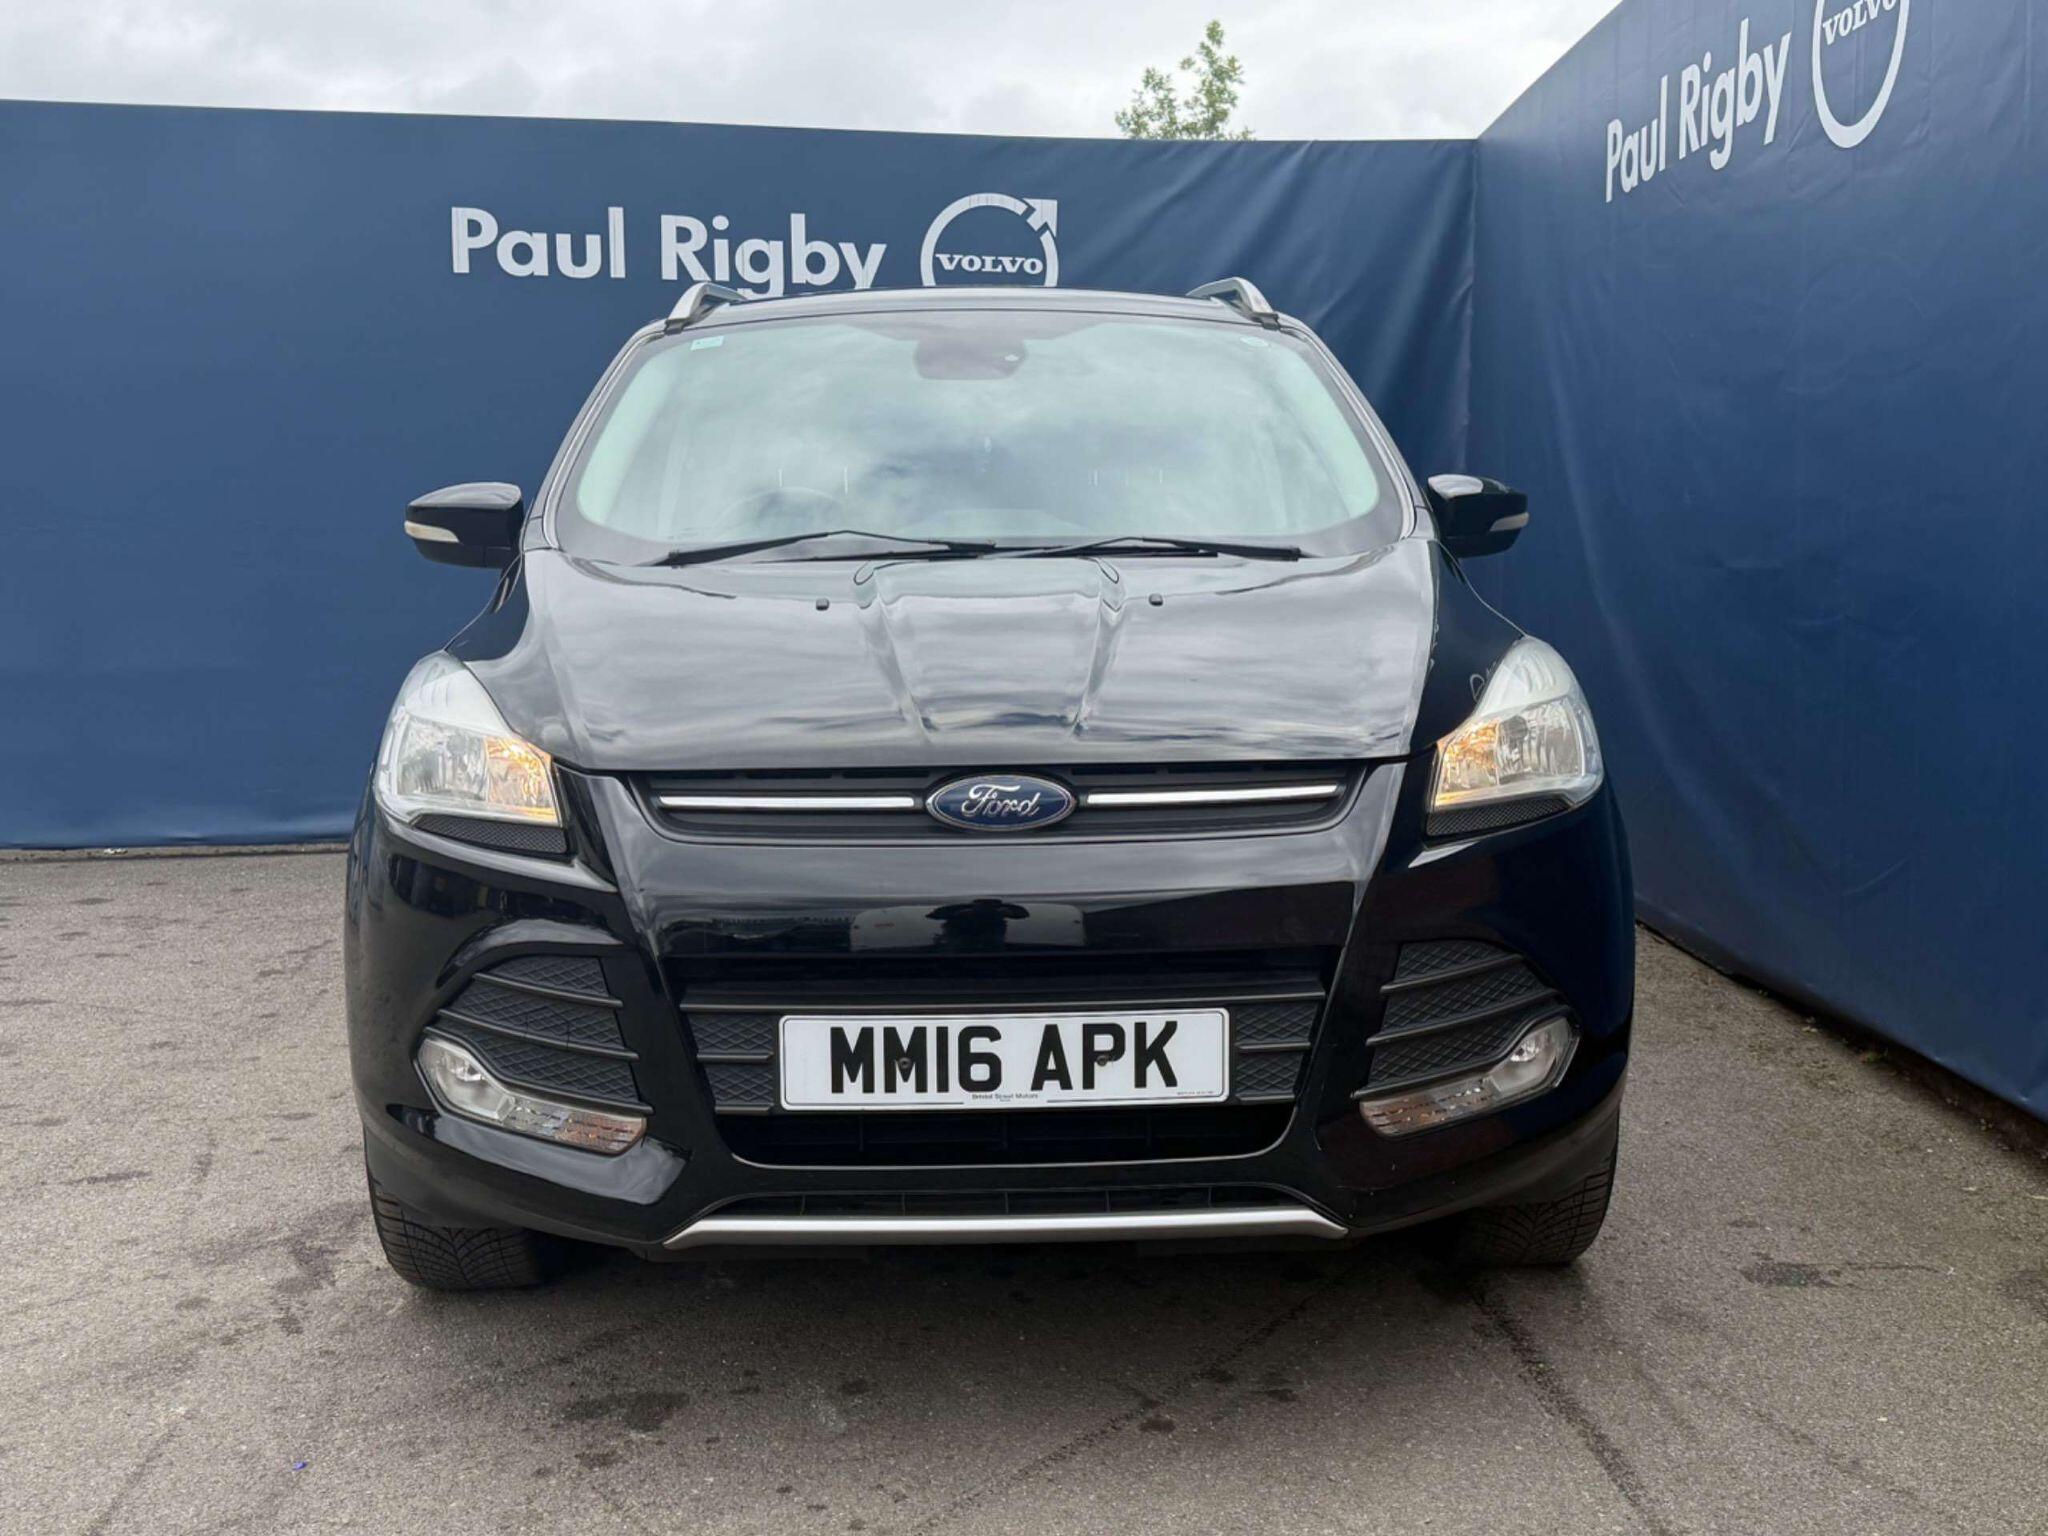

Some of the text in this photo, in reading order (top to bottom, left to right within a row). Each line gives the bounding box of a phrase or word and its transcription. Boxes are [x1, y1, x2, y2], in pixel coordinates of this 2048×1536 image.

[1606, 17, 1792, 202] Paul Rigby
[451, 206, 888, 299] Paul Rigby
[935, 253, 1044, 275] VOLVO
[961, 784, 1041, 817] Ford
[830, 1021, 1178, 1094] MM16 APK
